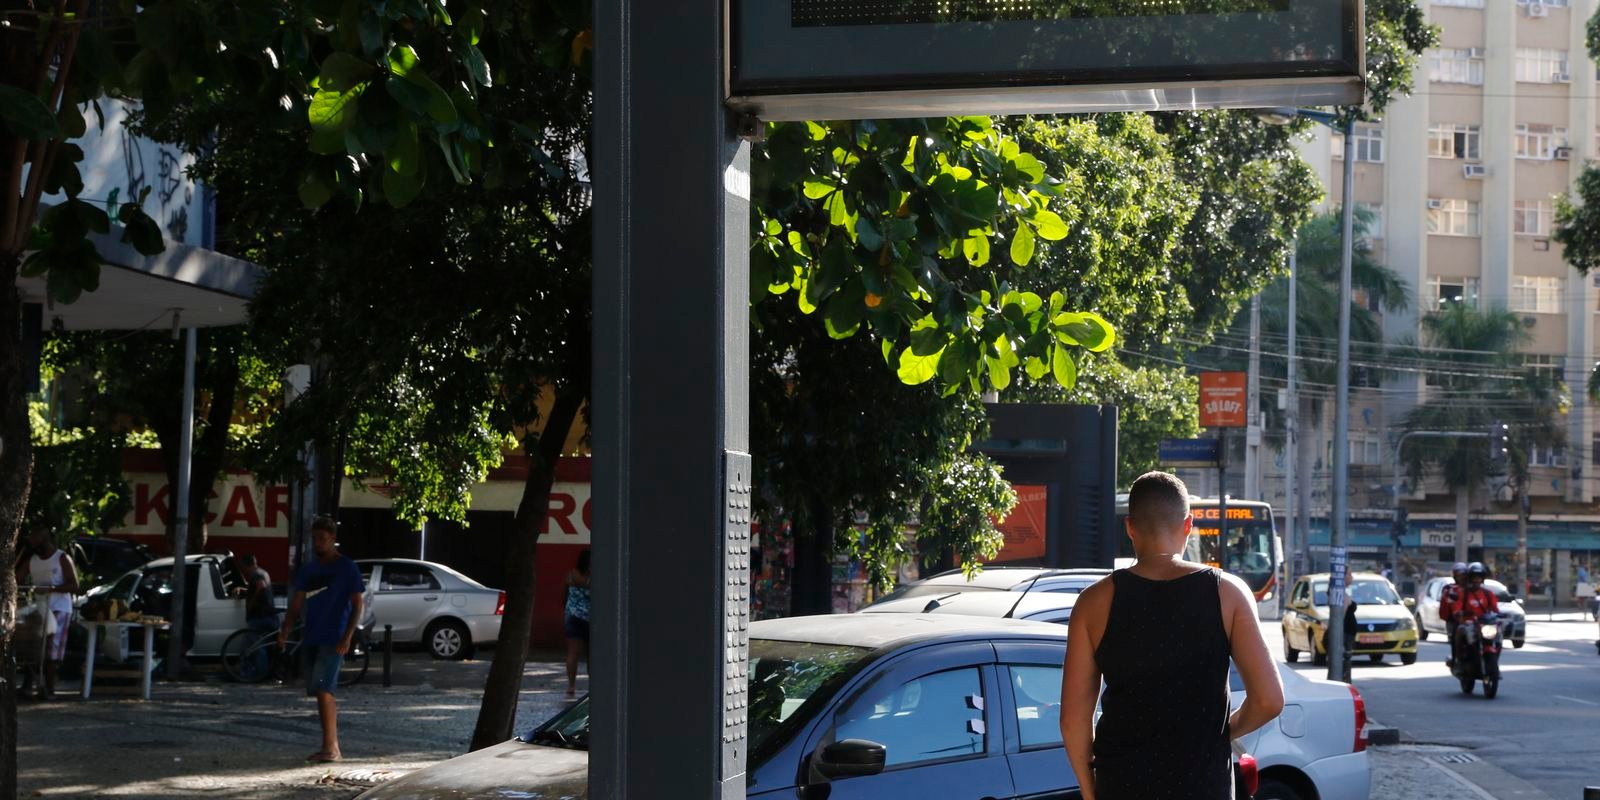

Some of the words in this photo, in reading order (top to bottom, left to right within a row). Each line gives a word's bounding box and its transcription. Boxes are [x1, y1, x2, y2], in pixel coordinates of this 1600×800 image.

[1190, 508, 1204, 519] 15
[1205, 508, 1254, 519] CETRAL
[1428, 533, 1474, 543] mau
